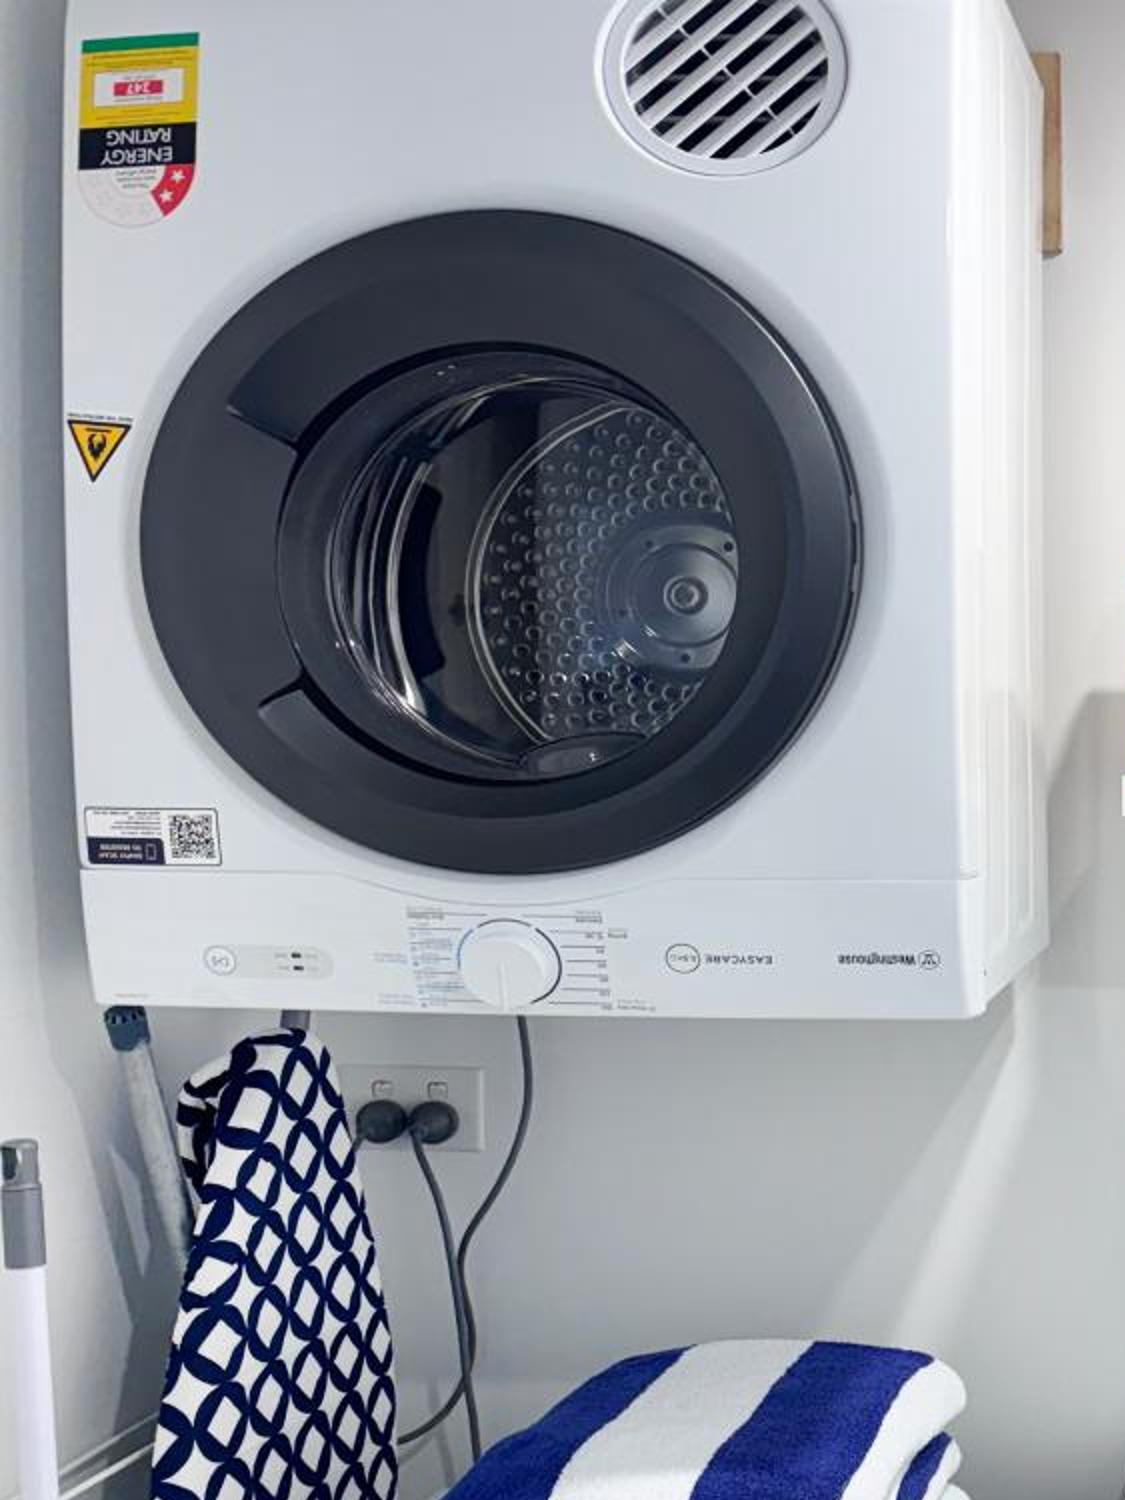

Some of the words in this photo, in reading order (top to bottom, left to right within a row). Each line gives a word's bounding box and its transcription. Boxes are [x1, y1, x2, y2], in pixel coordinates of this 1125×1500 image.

[106, 127, 171, 147] RATING
[101, 146, 174, 166] ENERGY
[705, 953, 773, 965] EASYCARE
[838, 953, 916, 967] Westinghouse
